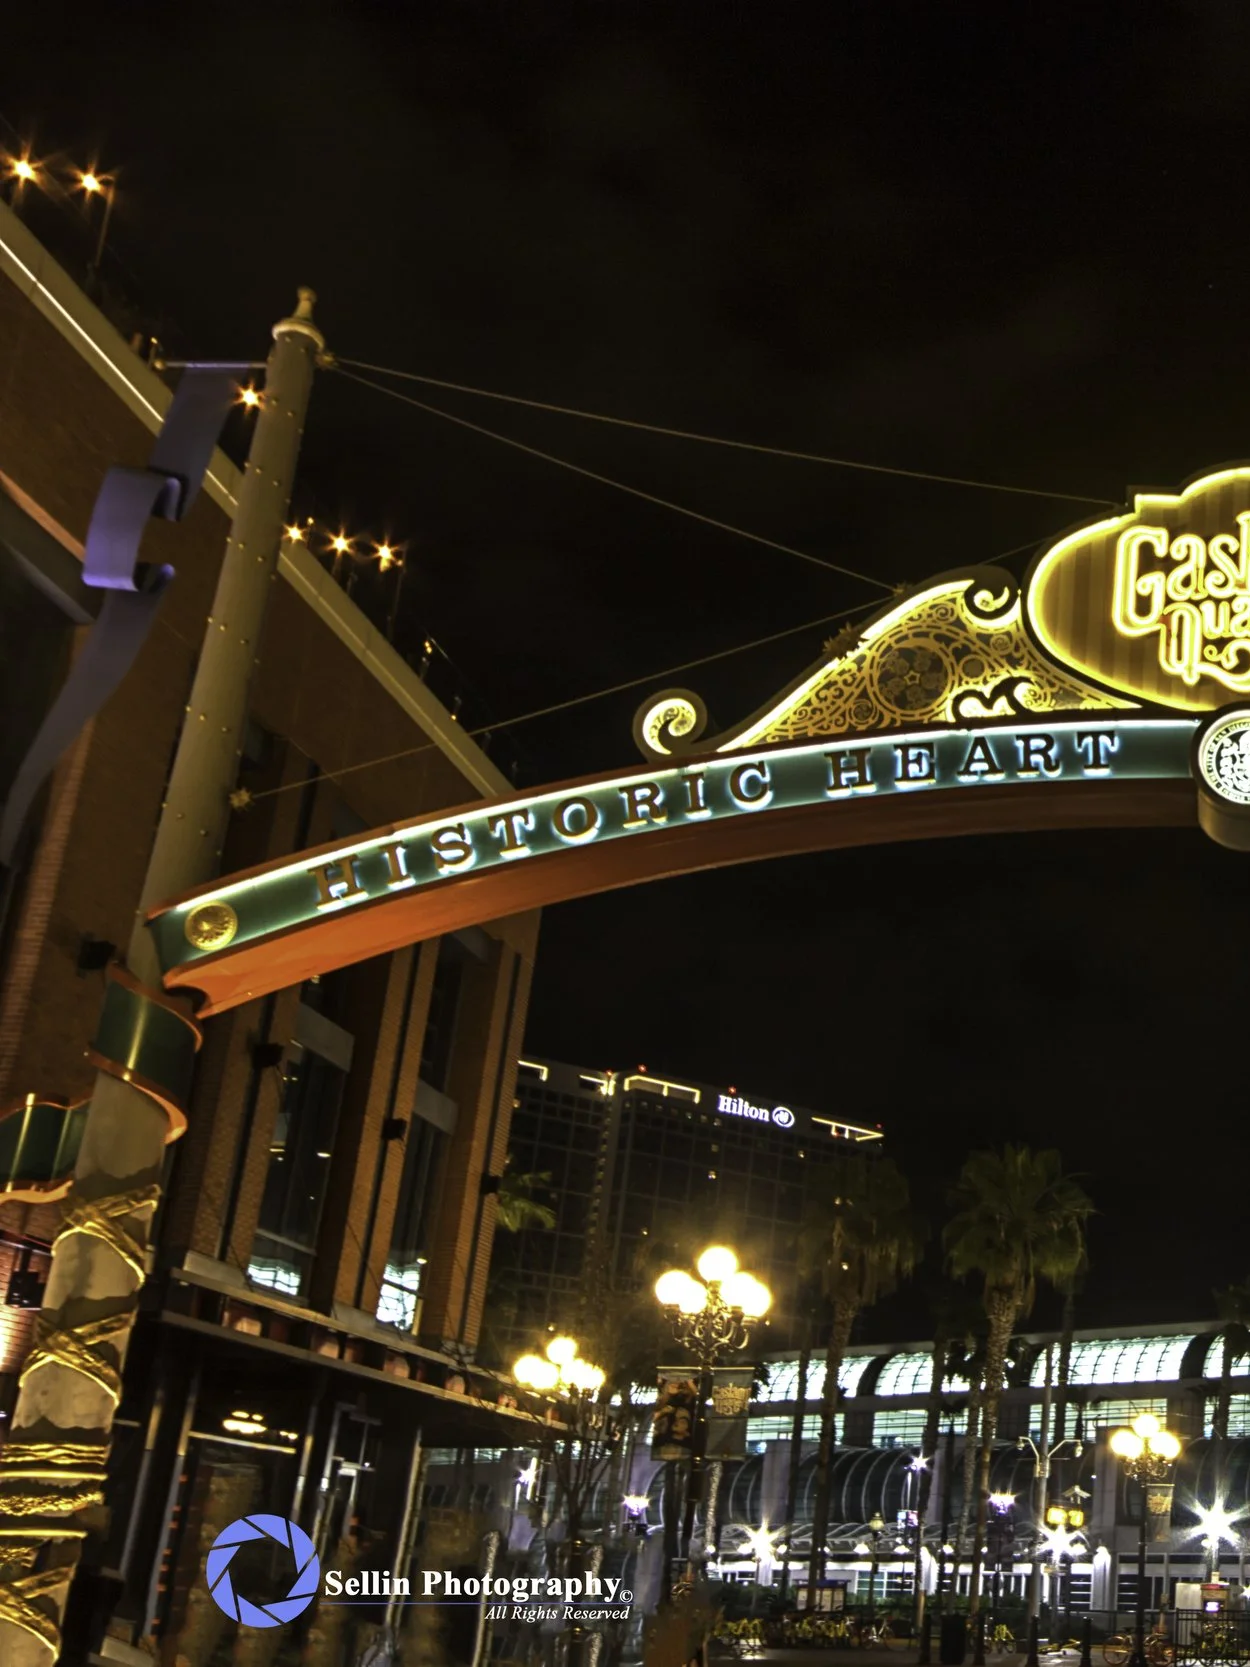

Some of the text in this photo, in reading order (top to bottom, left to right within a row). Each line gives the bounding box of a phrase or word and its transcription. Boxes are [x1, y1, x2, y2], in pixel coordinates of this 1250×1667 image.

[307, 760, 772, 911] HISTORIC
[823, 730, 1119, 797] HEART
[718, 1093, 770, 1122] Hilton
